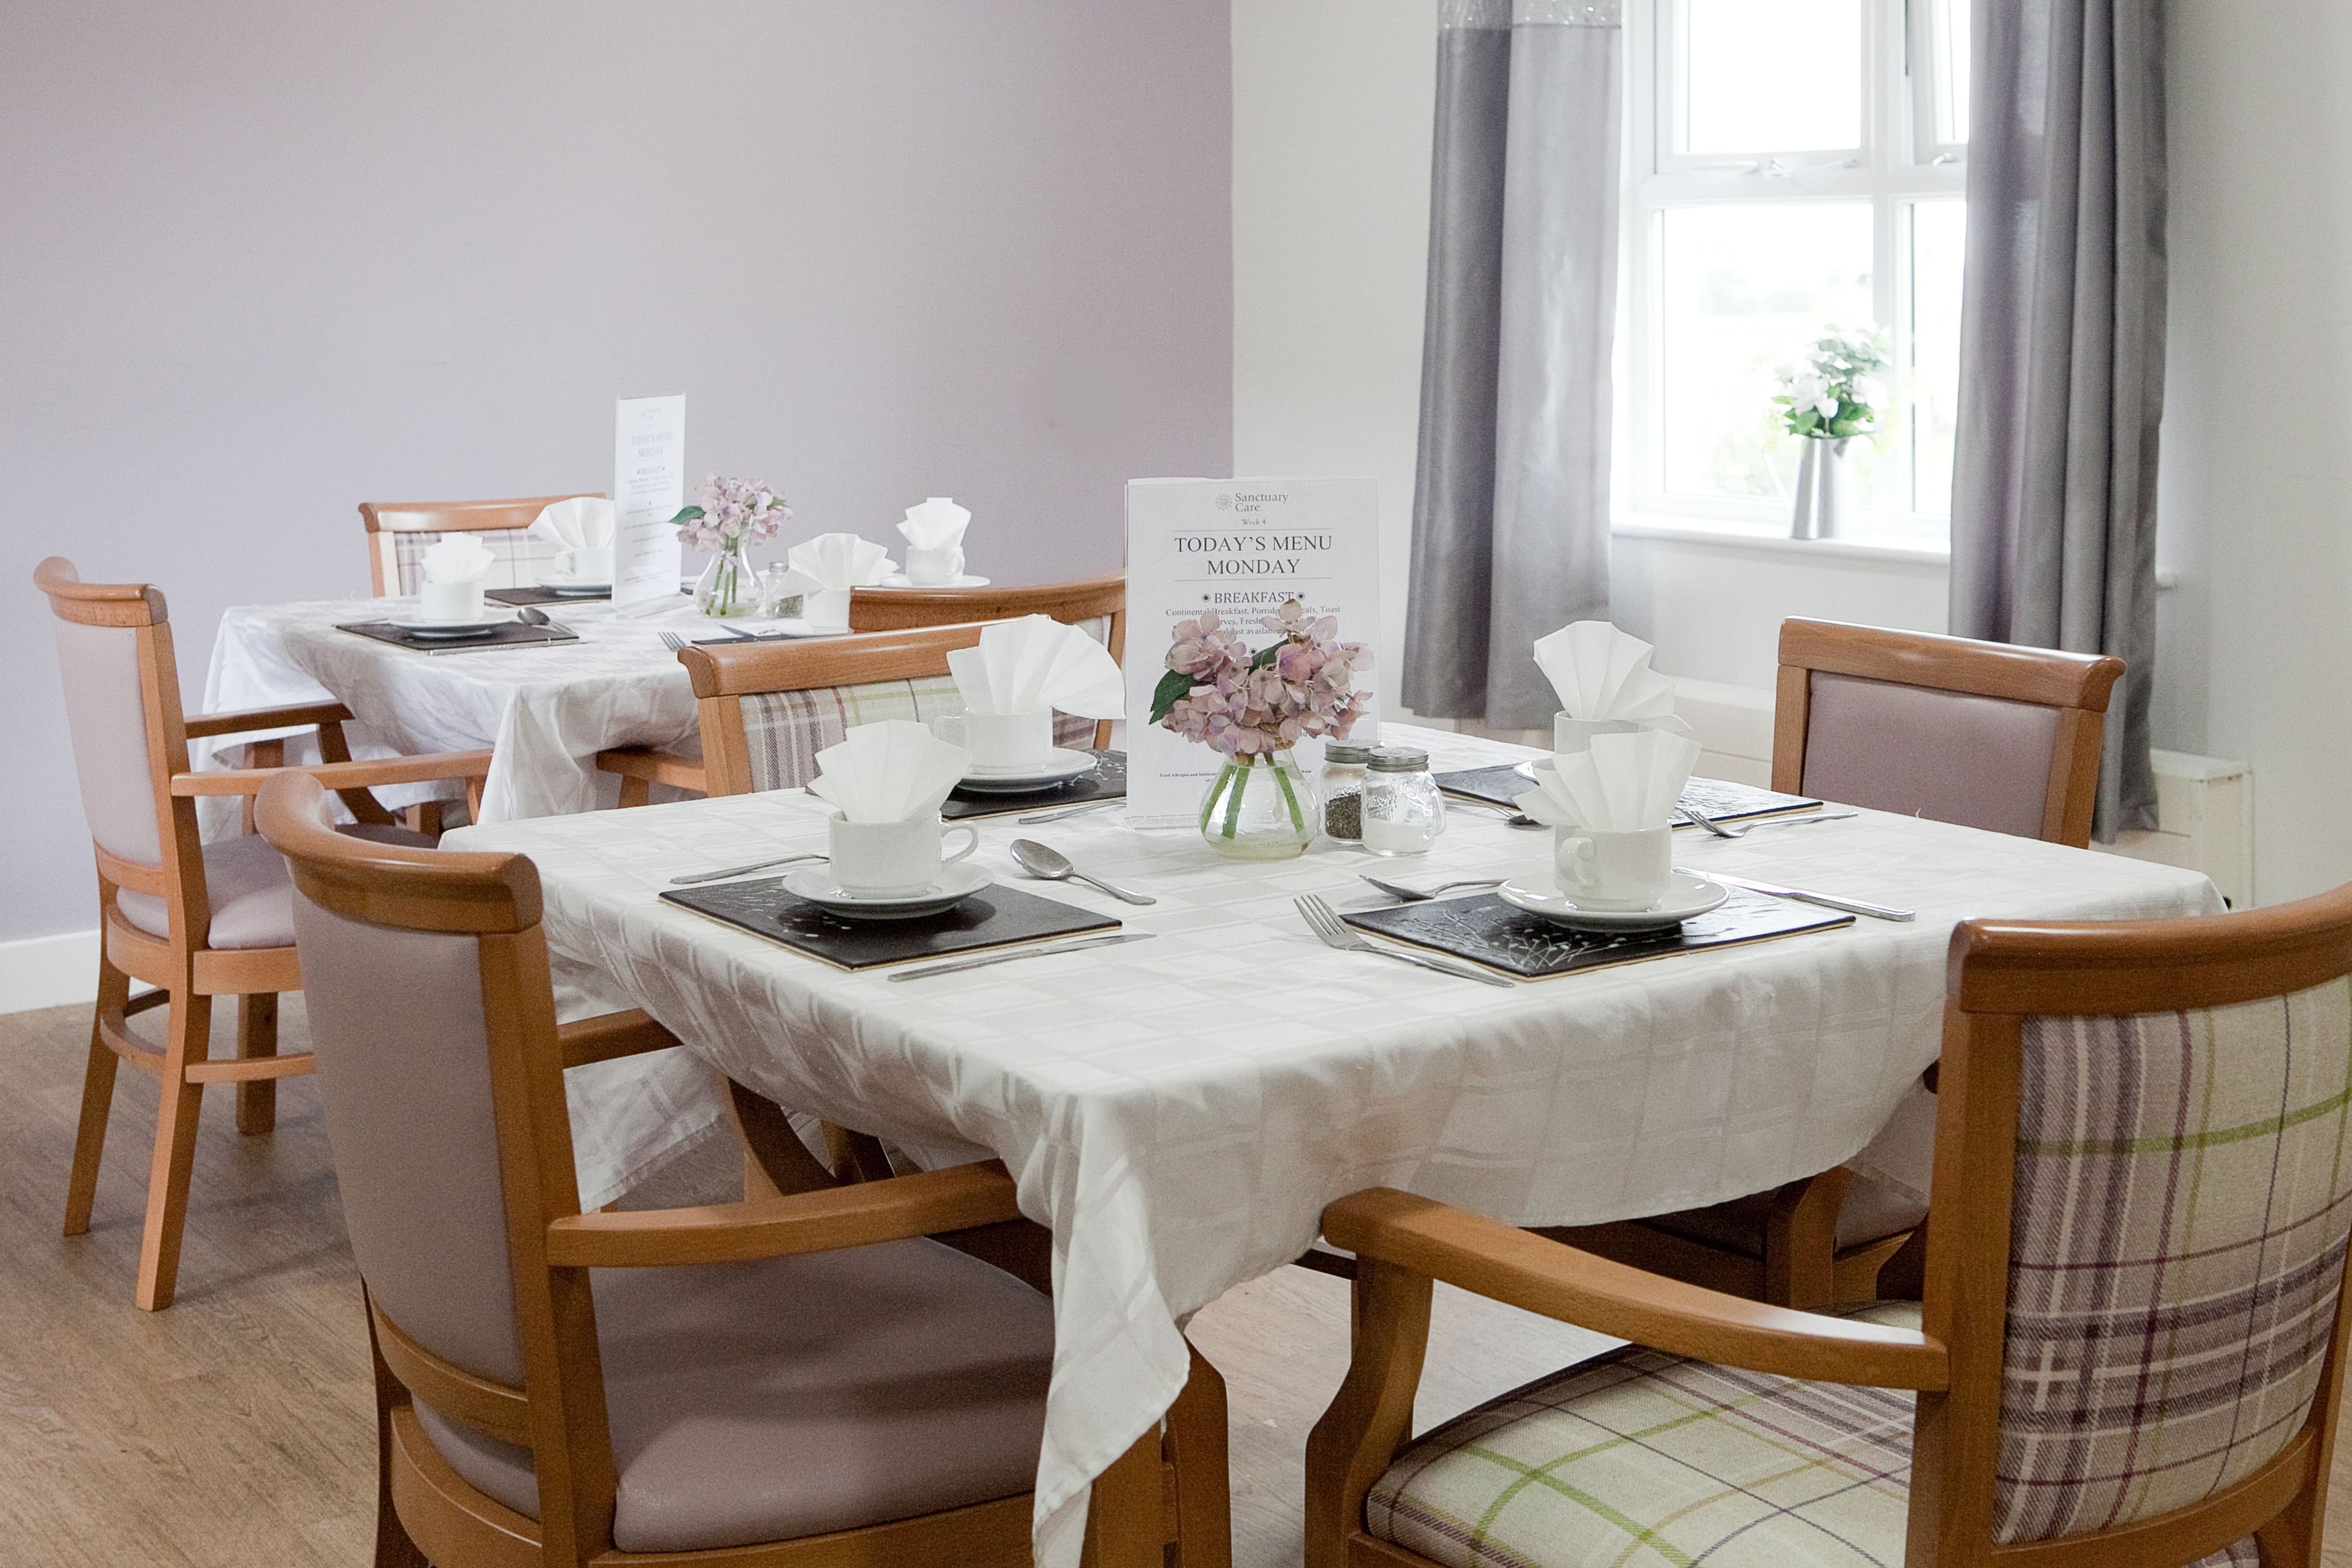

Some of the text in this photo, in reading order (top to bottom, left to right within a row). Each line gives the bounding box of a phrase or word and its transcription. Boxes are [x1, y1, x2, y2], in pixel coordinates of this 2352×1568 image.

[1235, 492, 1289, 504] Sanctuary
[1235, 502, 1261, 512] Care
[1174, 535, 1332, 552] TODAY'S MENU
[1207, 559, 1300, 575] MONDAY
[1215, 592, 1294, 603] BREAKFAST
[1252, 606, 1280, 616] Porridg
